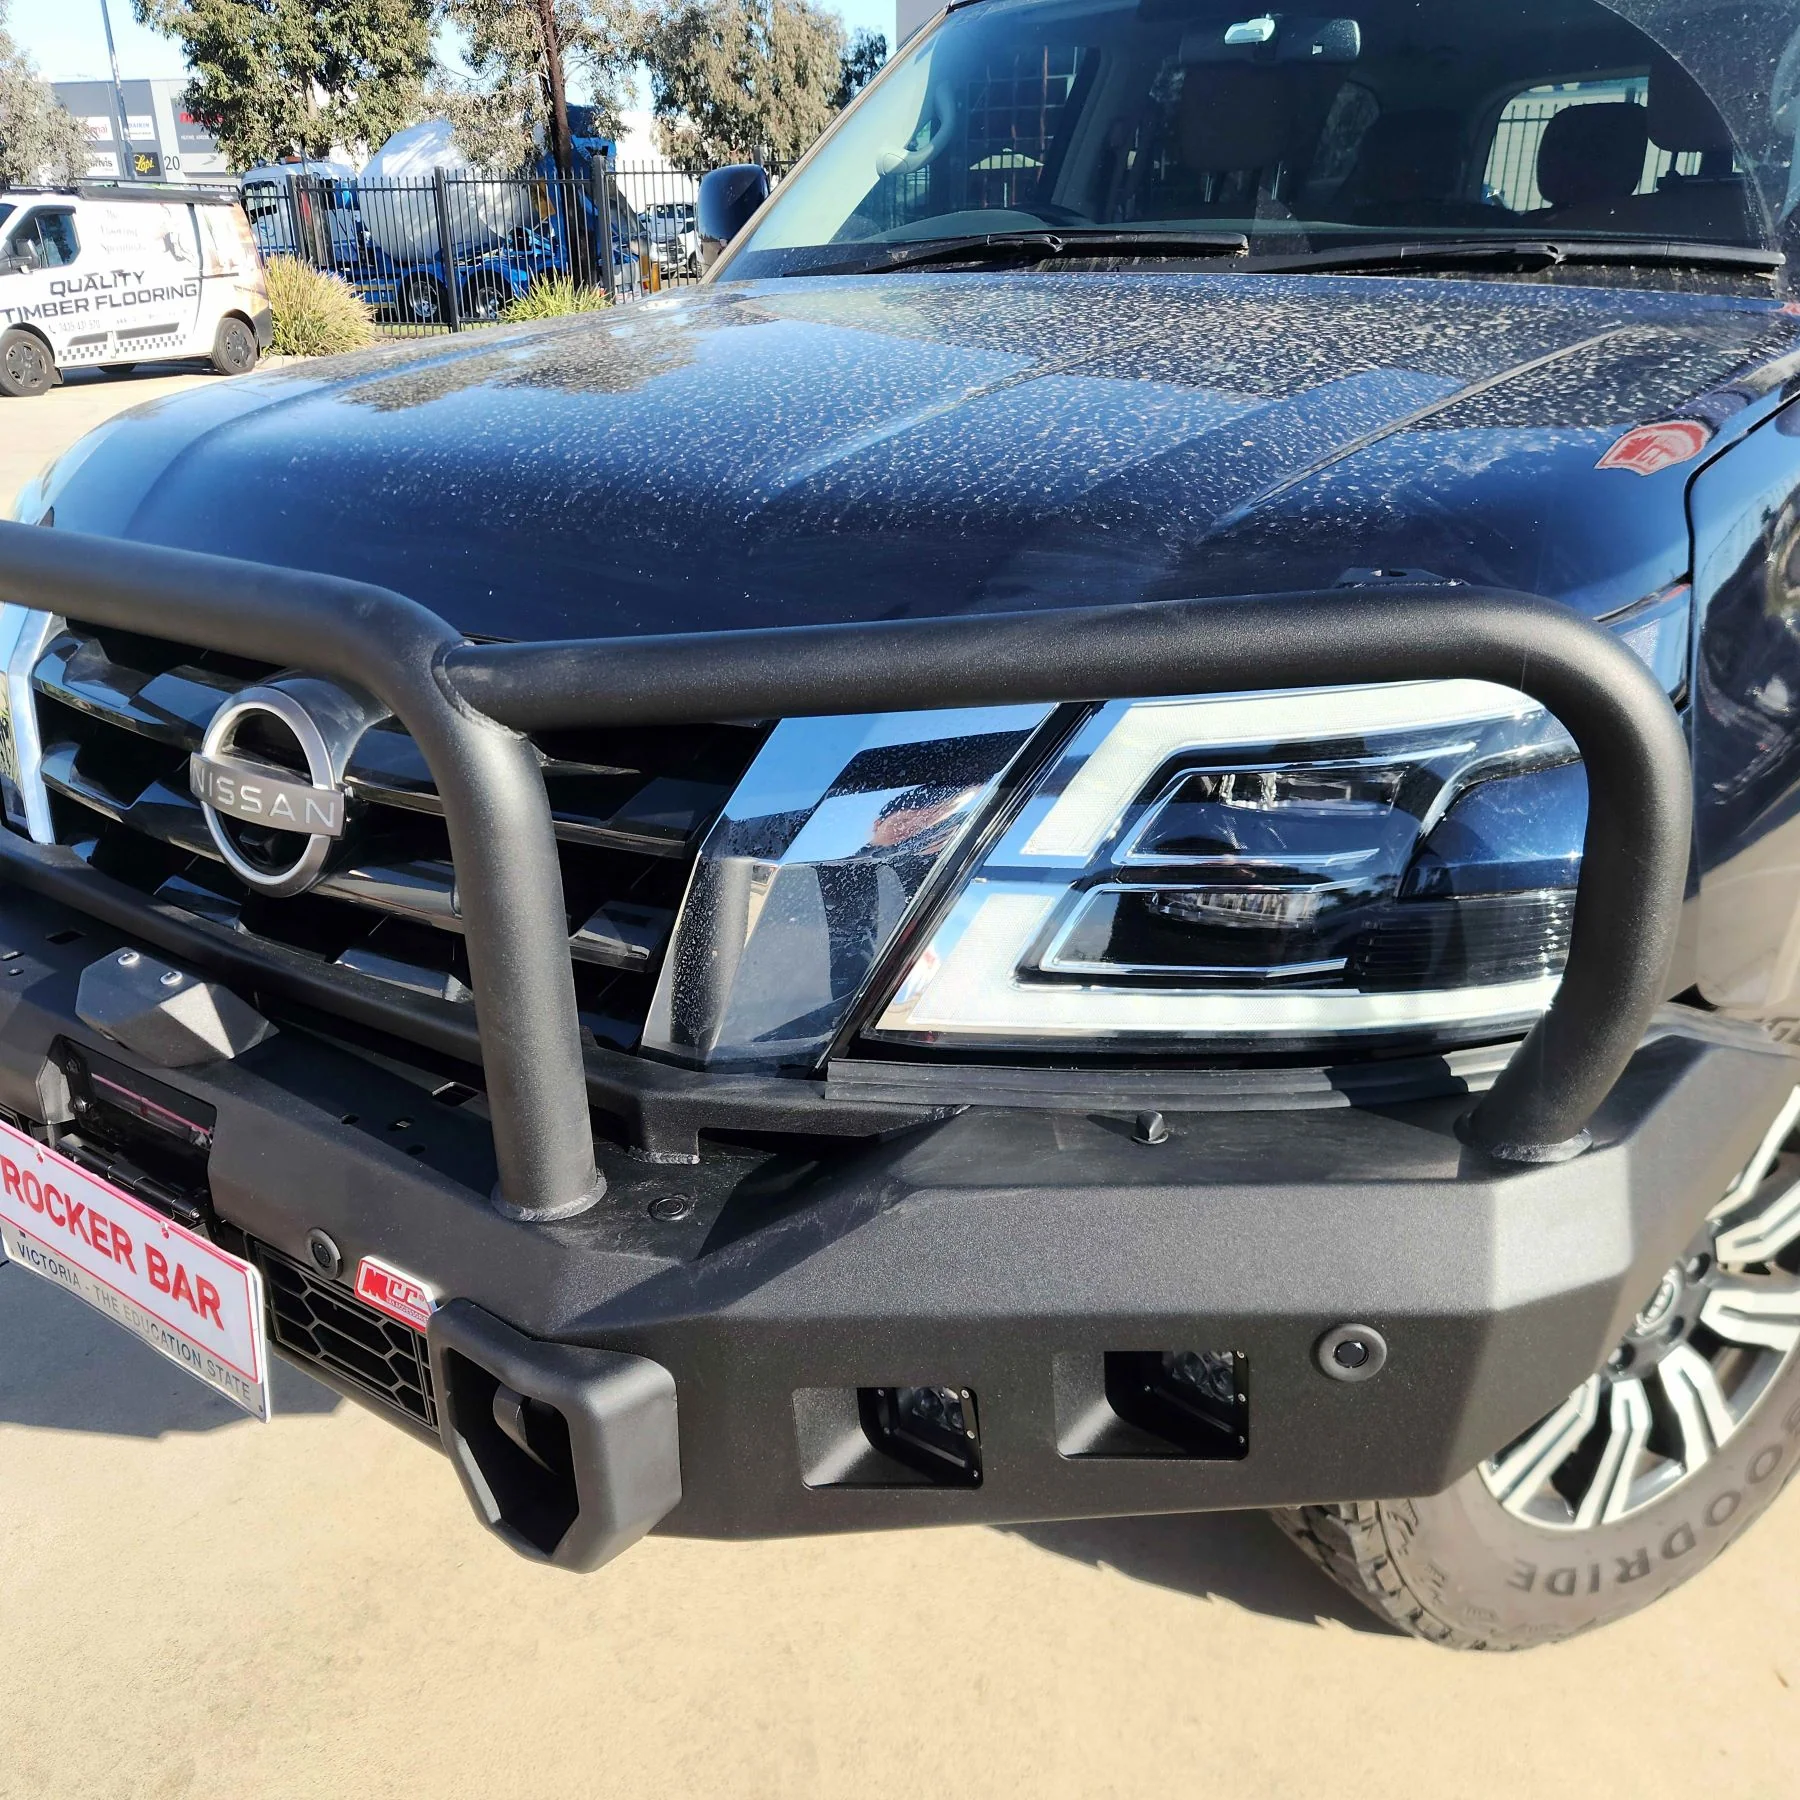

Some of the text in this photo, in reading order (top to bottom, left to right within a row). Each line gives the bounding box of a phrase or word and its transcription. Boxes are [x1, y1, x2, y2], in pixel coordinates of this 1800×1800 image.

[164, 155, 180, 171] 20
[0, 297, 89, 323] TIMBER
[95, 283, 198, 310] FLOORING
[50, 270, 145, 297] QUALITY
[192, 762, 336, 829] NISSAN
[1, 1156, 225, 1331] ROCKER BAR
[16, 1241, 81, 1290] VICTORIA
[93, 1284, 119, 1316] THE
[124, 1302, 203, 1370] EDUCATION
[207, 1359, 251, 1400] STATE
